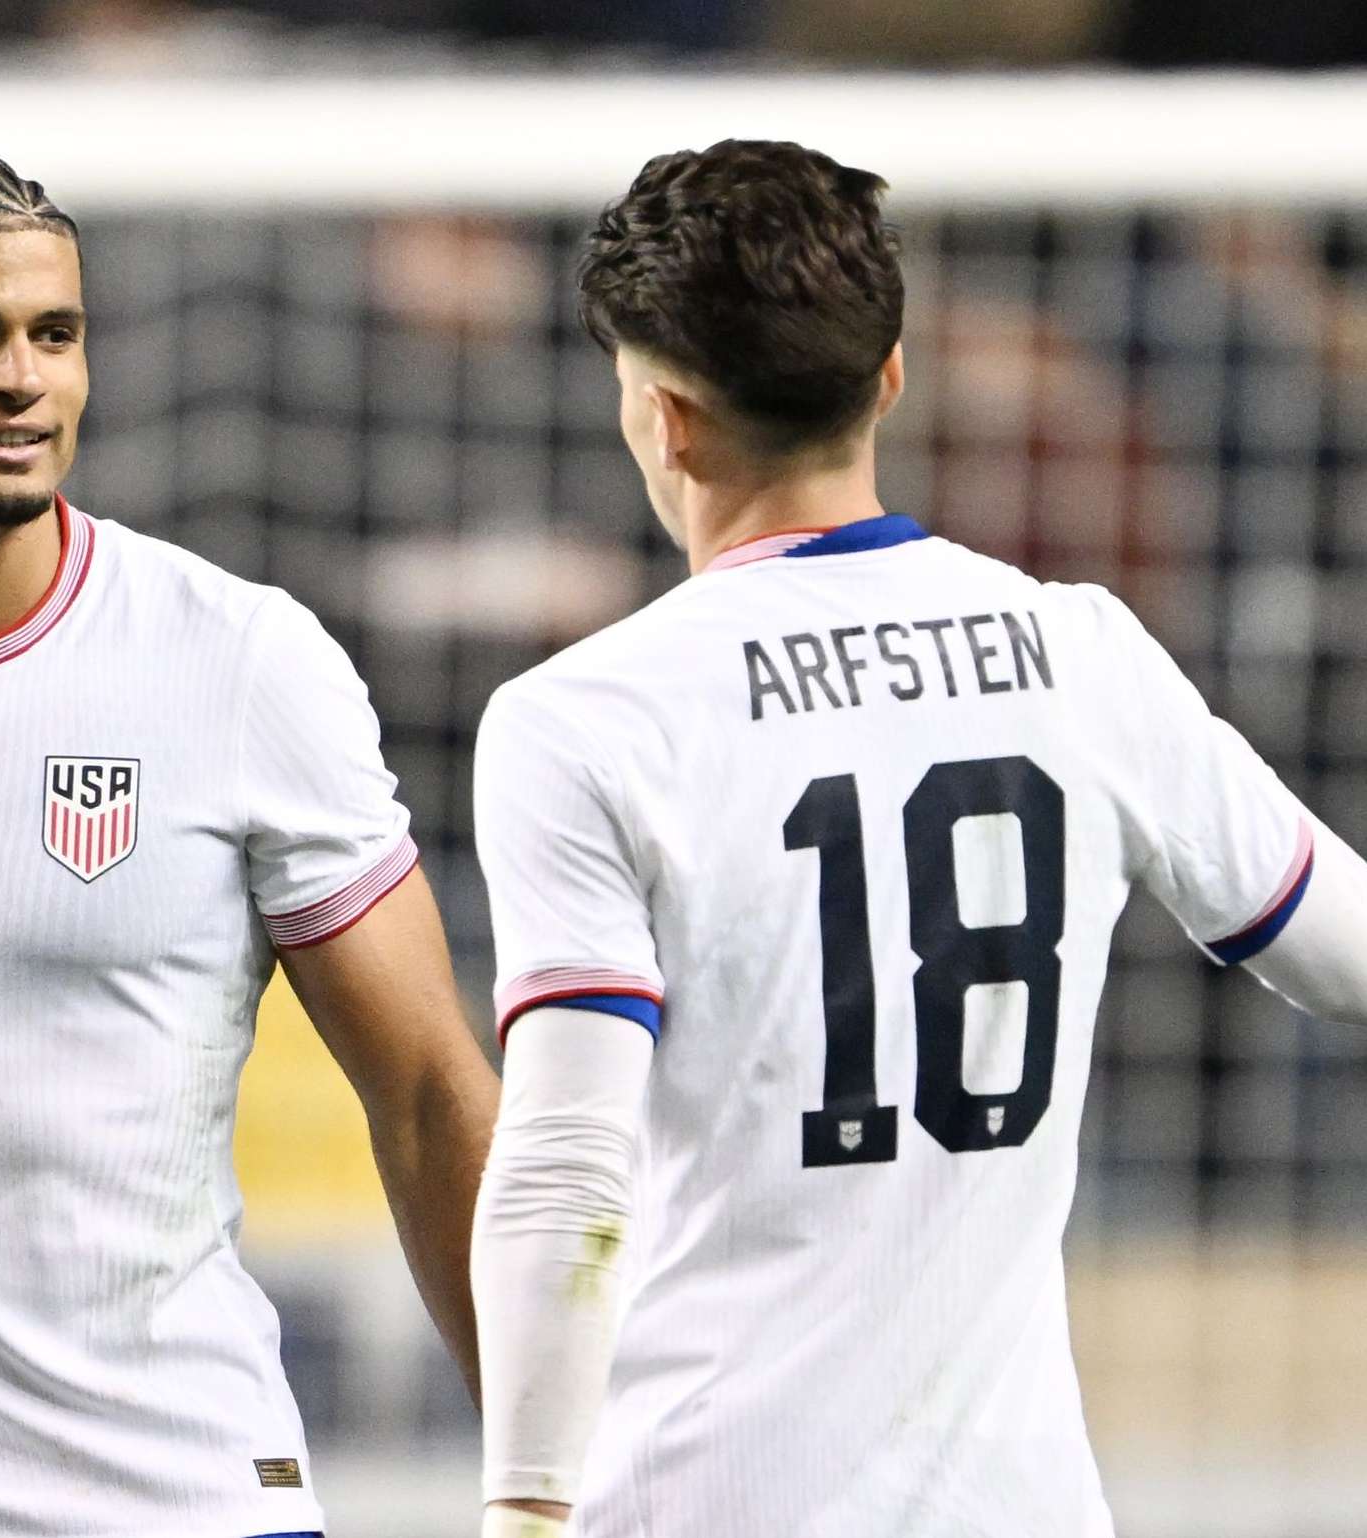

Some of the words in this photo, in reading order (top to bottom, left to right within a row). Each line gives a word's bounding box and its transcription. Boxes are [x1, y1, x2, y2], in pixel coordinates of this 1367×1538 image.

[742, 611, 1054, 720] ARFSTEN
[52, 764, 132, 809] USA
[782, 755, 1065, 1168] 18
